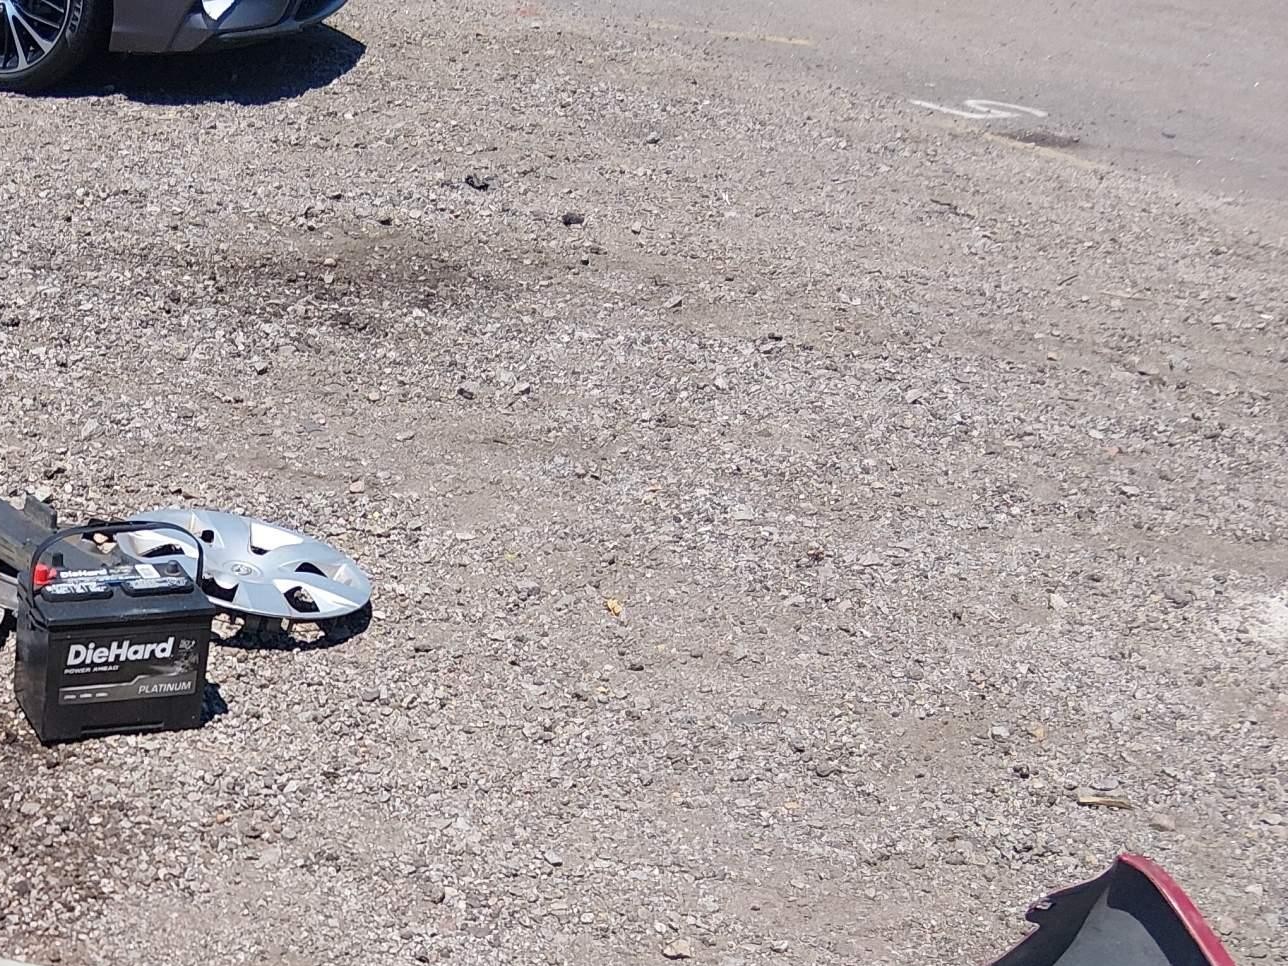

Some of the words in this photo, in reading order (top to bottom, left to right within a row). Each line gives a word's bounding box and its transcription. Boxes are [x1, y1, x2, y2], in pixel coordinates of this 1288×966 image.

[60, 569, 107, 579] DieHard
[66, 636, 176, 666] DieHard
[64, 667, 91, 675] POWER
[92, 665, 120, 673] AHEAD
[138, 680, 192, 695] PLATINUM
